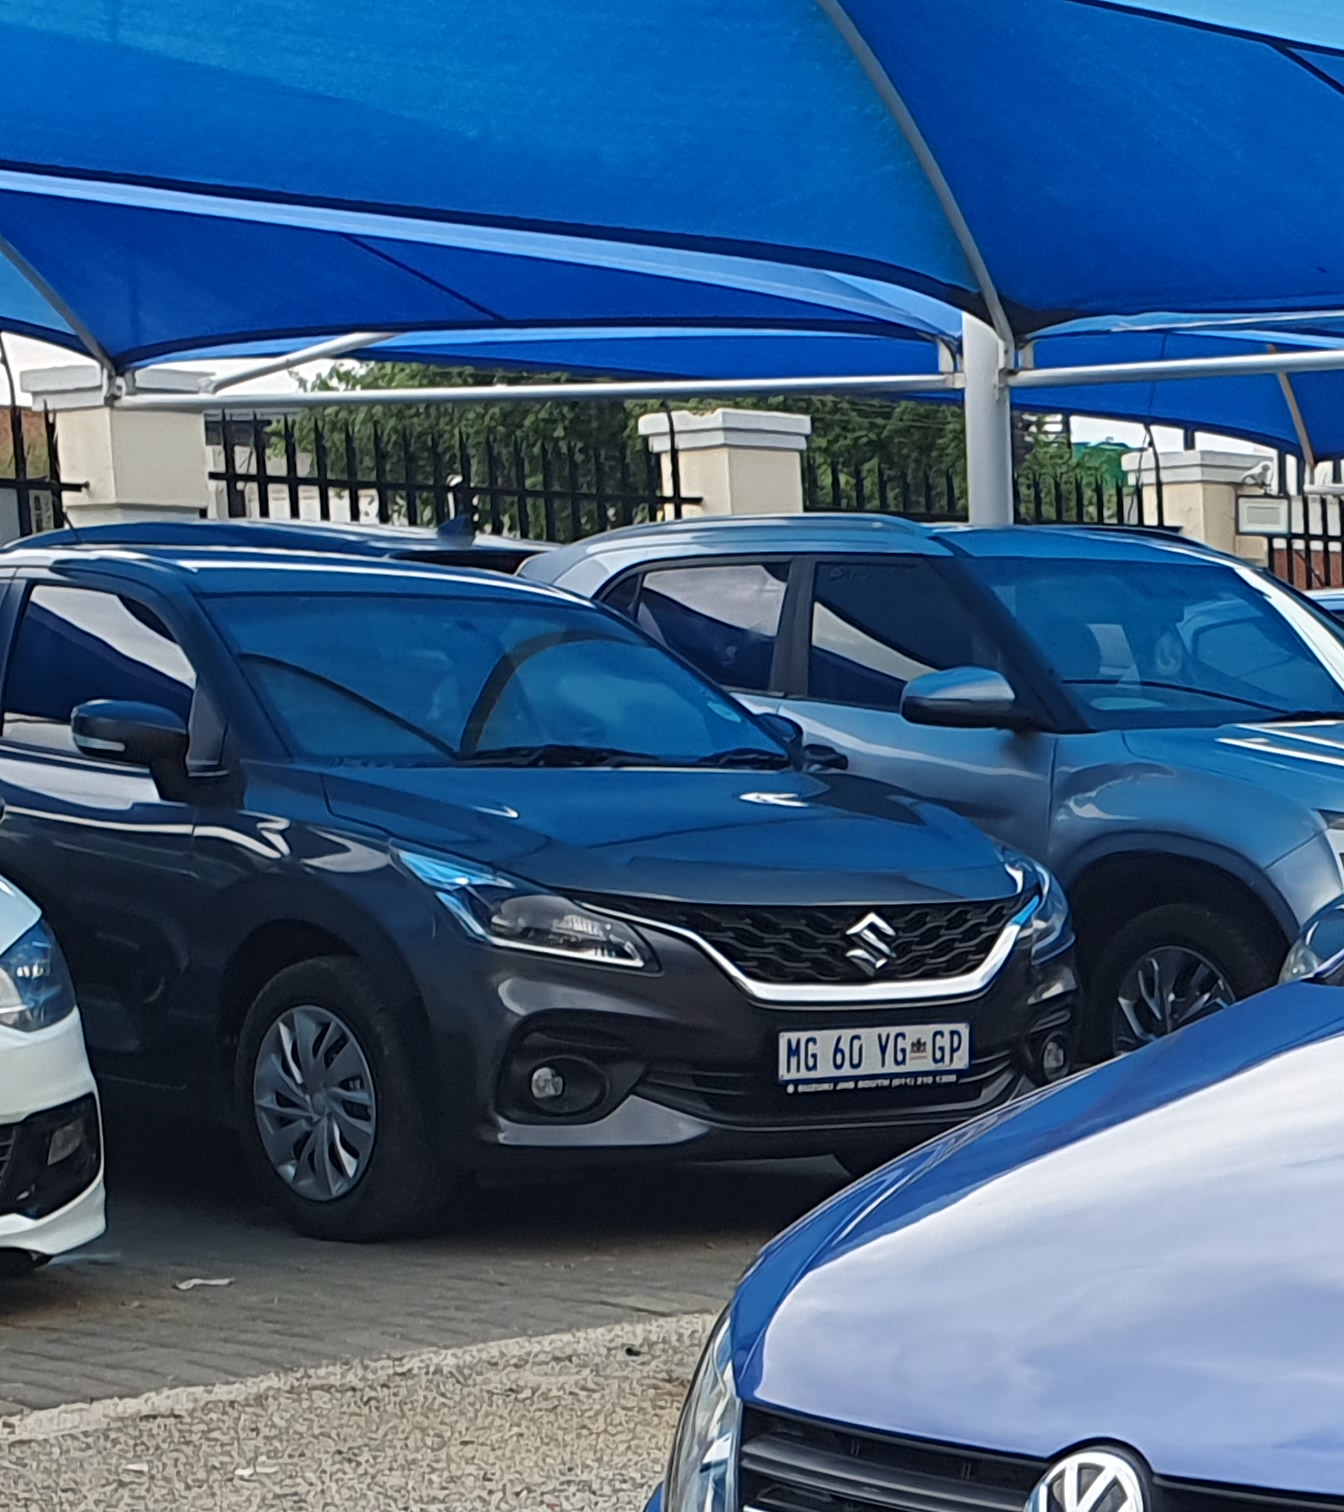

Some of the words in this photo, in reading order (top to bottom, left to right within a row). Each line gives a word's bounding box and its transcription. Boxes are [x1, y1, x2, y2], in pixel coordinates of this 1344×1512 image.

[786, 1037, 818, 1074] MG
[832, 1034, 863, 1071] 60
[877, 1032, 907, 1068] YG
[931, 1030, 962, 1066] GP
